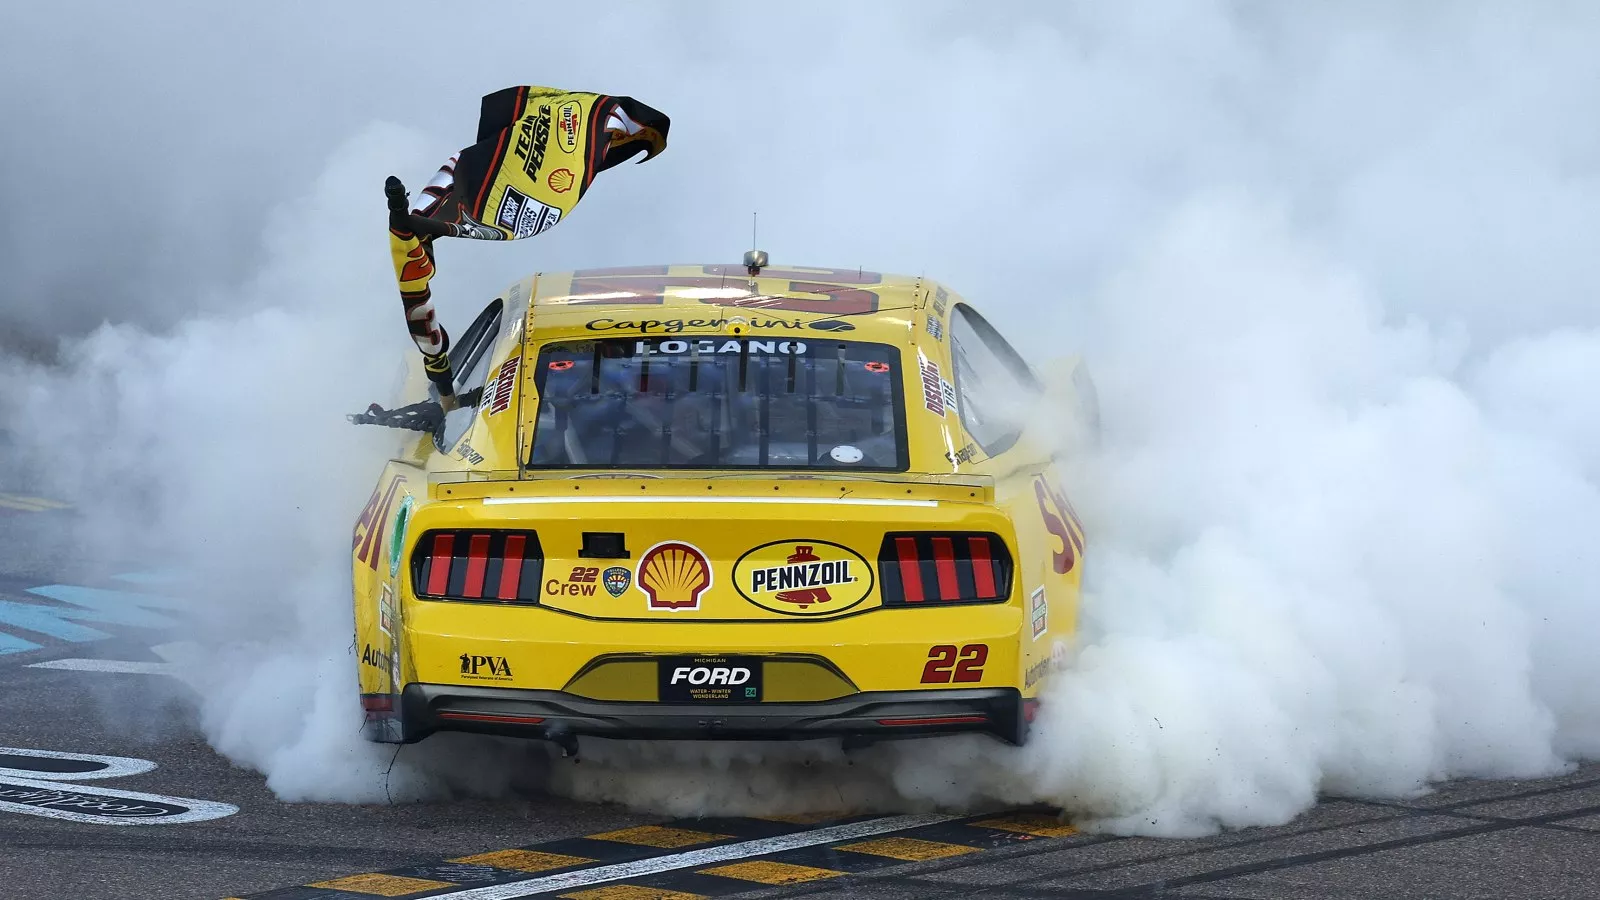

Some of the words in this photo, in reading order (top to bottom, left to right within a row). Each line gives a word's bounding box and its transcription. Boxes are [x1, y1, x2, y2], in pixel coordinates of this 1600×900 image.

[514, 115, 537, 160] TEAM
[563, 104, 575, 146] PENNZOIL
[523, 104, 551, 183] PENSKE
[636, 340, 807, 355] LOGANO
[481, 381, 496, 409] TIRE
[490, 357, 520, 416] DISCOUNT
[942, 381, 954, 410] TIRE
[545, 579, 597, 596] Crew
[568, 566, 600, 583] 22
[752, 559, 856, 592] PENNZOIL
[470, 655, 513, 677] PVA
[670, 667, 751, 685] FORD
[920, 644, 989, 684] 22
